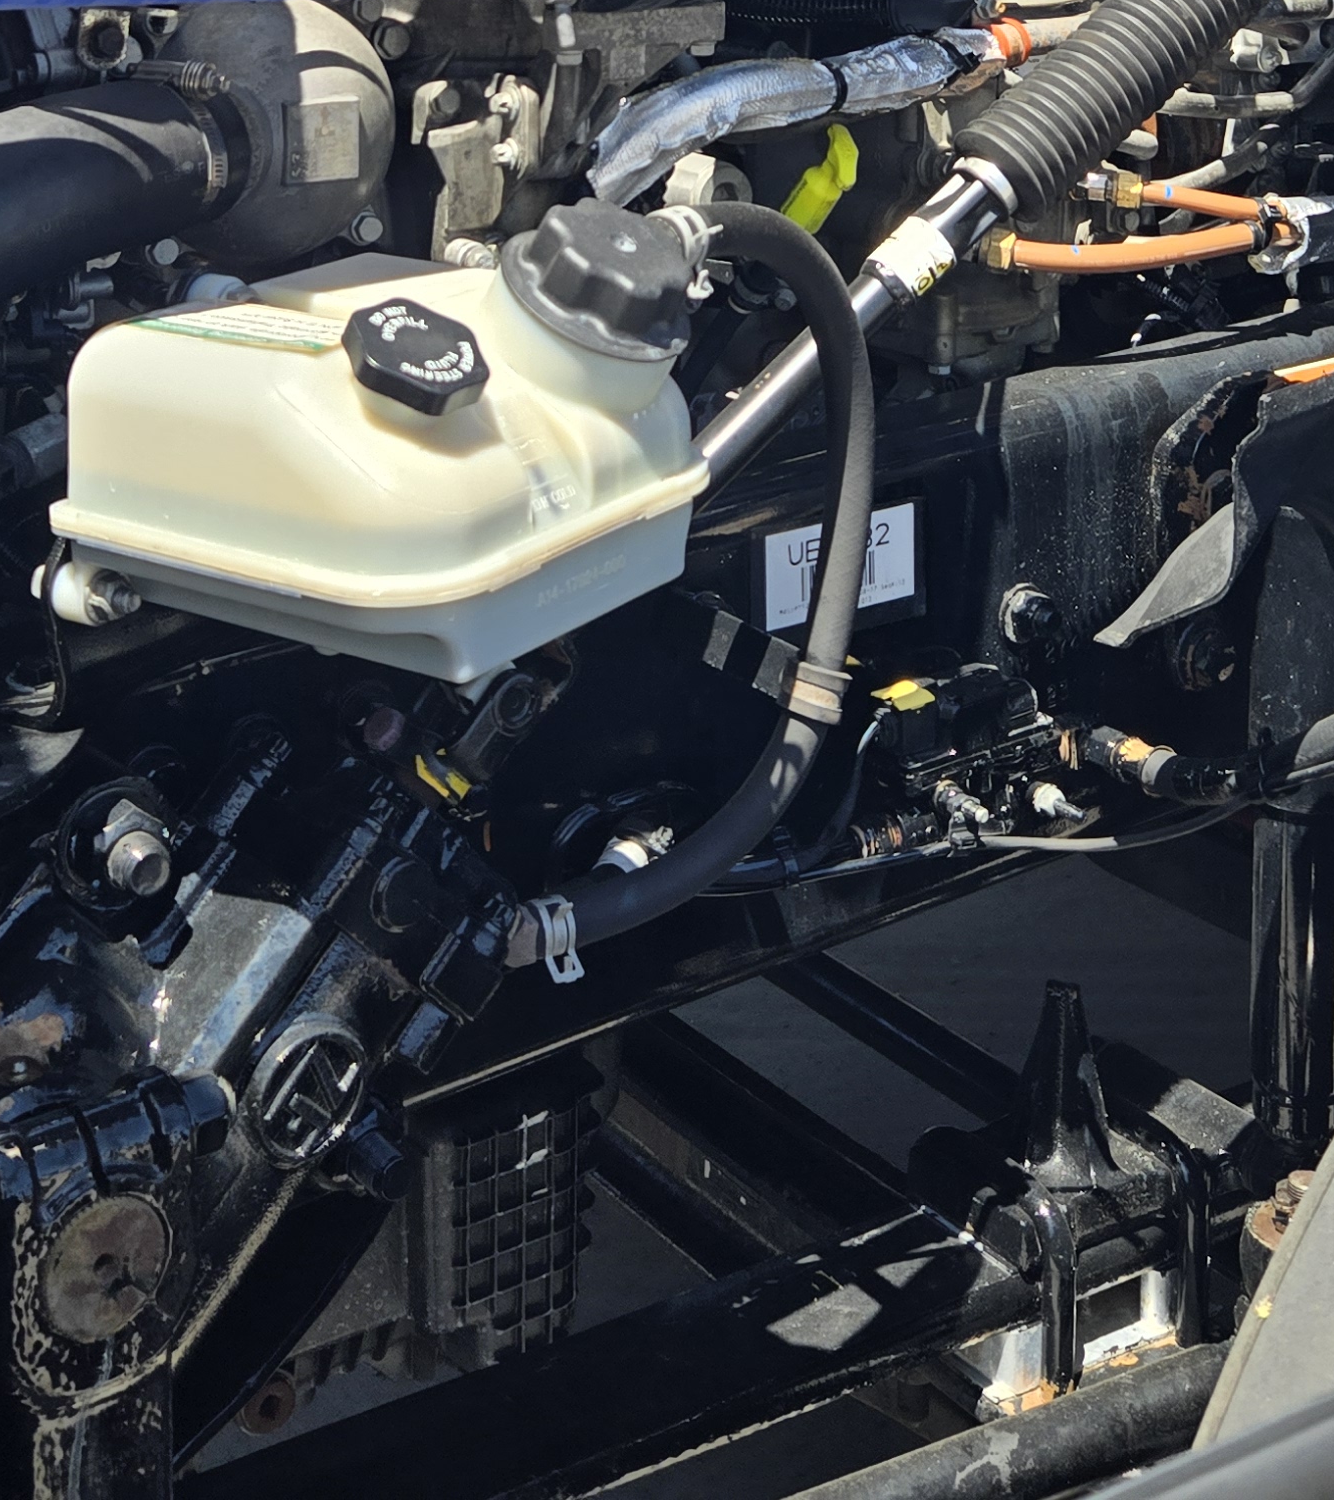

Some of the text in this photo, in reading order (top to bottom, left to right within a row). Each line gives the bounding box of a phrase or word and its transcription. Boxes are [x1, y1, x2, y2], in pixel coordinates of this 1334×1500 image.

[381, 305, 407, 318] NOT
[424, 350, 459, 371] FLUID
[399, 361, 464, 382] STEERING
